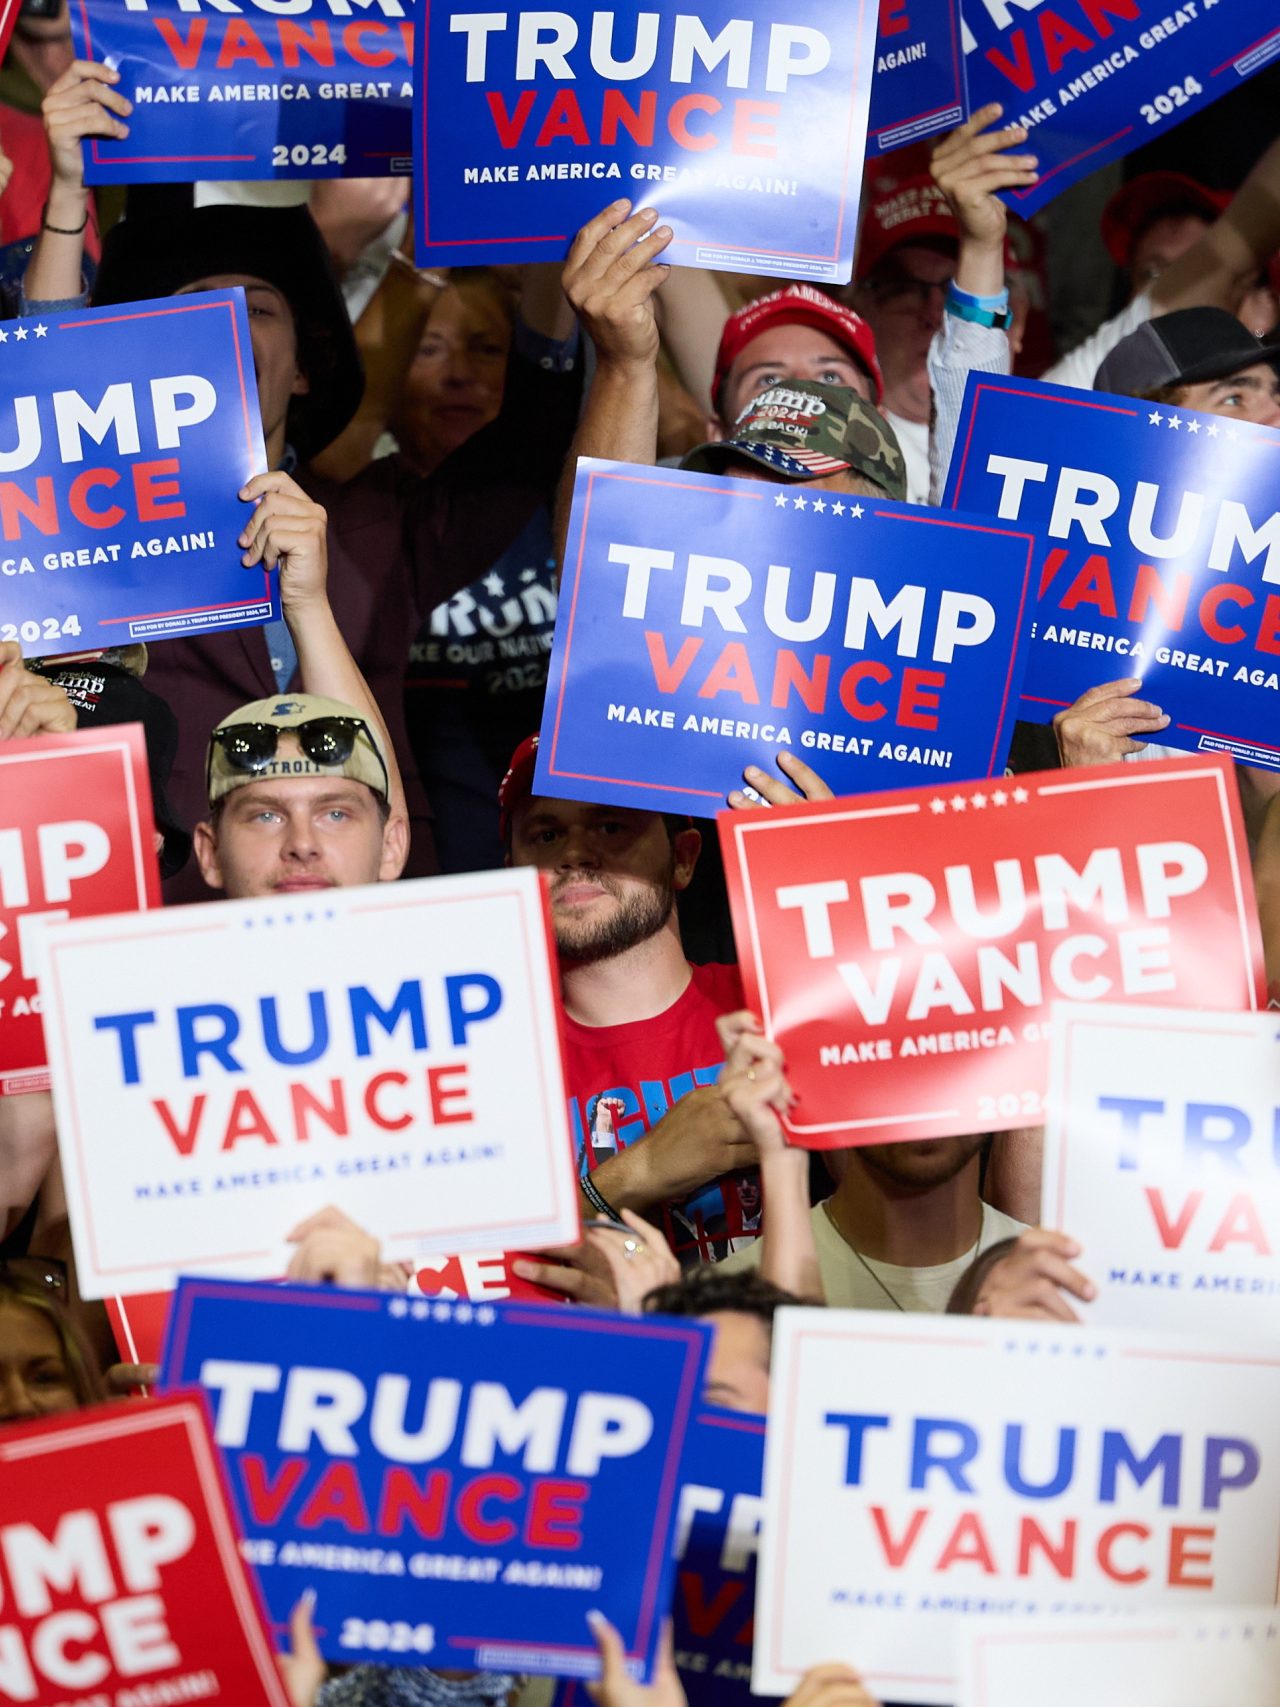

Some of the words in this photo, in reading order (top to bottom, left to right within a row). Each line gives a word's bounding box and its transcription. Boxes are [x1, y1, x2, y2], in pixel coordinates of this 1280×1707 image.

[449, 11, 831, 93] TRUMP
[876, 42, 927, 74] AGAIN!
[1057, 46, 1140, 106] AMERICA
[1138, 2, 1199, 50] GREAT
[136, 86, 200, 104] MAKE
[208, 85, 311, 102] AMERICA
[319, 83, 391, 99] GREAT
[486, 89, 782, 159] VANCE
[1139, 75, 1204, 126] 2024
[272, 144, 347, 167] 2024
[464, 164, 519, 185] MAKE
[526, 162, 622, 181] AMERICA
[715, 174, 799, 197] AGAIN!
[757, 405, 799, 420] 2024
[43, 544, 122, 571] GREAT
[131, 532, 216, 560] AGAIN!
[1, 614, 82, 644] 2024
[607, 542, 996, 664] TRUMP
[445, 641, 495, 664] OUR
[644, 631, 946, 732] VANCE
[1043, 625, 1144, 658] AMERICA
[1154, 647, 1229, 678] GREAT
[606, 704, 675, 729] MAKE
[682, 713, 792, 745] AMERICA
[800, 731, 874, 756] GREAT
[878, 741, 954, 769] AGAIN!
[776, 840, 1209, 959] TRUMP
[836, 926, 1177, 1027] VANCE
[93, 972, 504, 1086] TRUMP
[819, 1040, 893, 1067] MAKE
[899, 1025, 1015, 1058] AMERICA
[152, 1064, 475, 1157] VANCE
[134, 1178, 203, 1200] MAKE
[213, 1164, 327, 1192] AMERICA
[336, 1154, 413, 1178] GREAT
[424, 1143, 506, 1167] AGAIN!
[200, 1358, 655, 1478] TRUMP
[823, 1411, 1261, 1510] TRUMP
[239, 1452, 590, 1552] VANCE
[277, 1542, 406, 1577] AMERICA
[408, 1553, 502, 1585] GREAT
[869, 1504, 1217, 1590] VANCE
